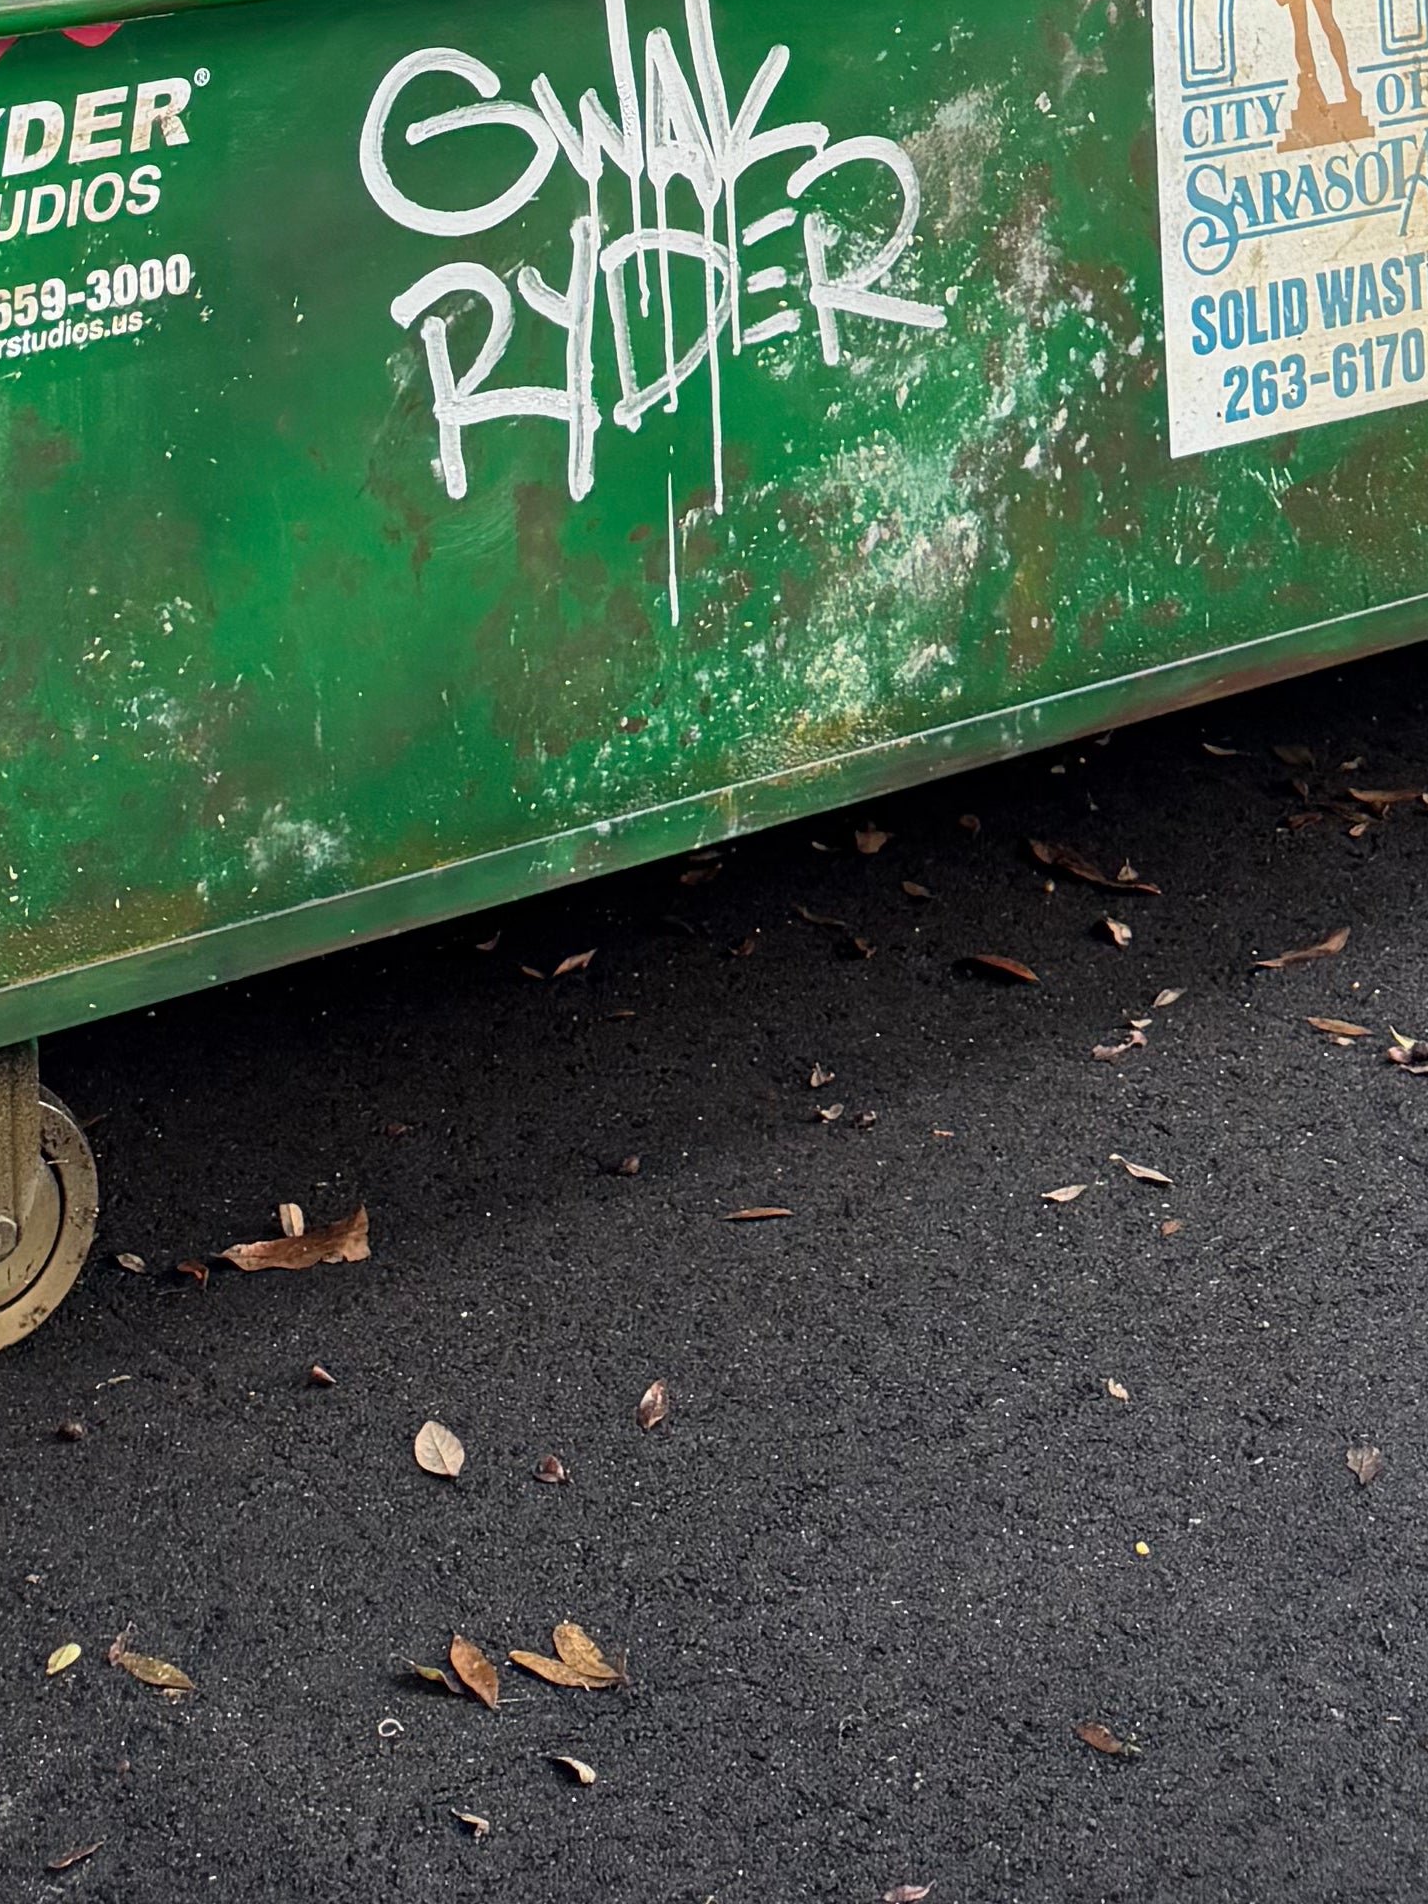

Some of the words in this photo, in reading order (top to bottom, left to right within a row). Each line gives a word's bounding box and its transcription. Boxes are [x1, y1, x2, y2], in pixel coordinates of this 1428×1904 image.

[1182, 91, 1286, 149] CITY
[1190, 276, 1310, 358] SOLID
[1222, 325, 1427, 424] 263-6170
